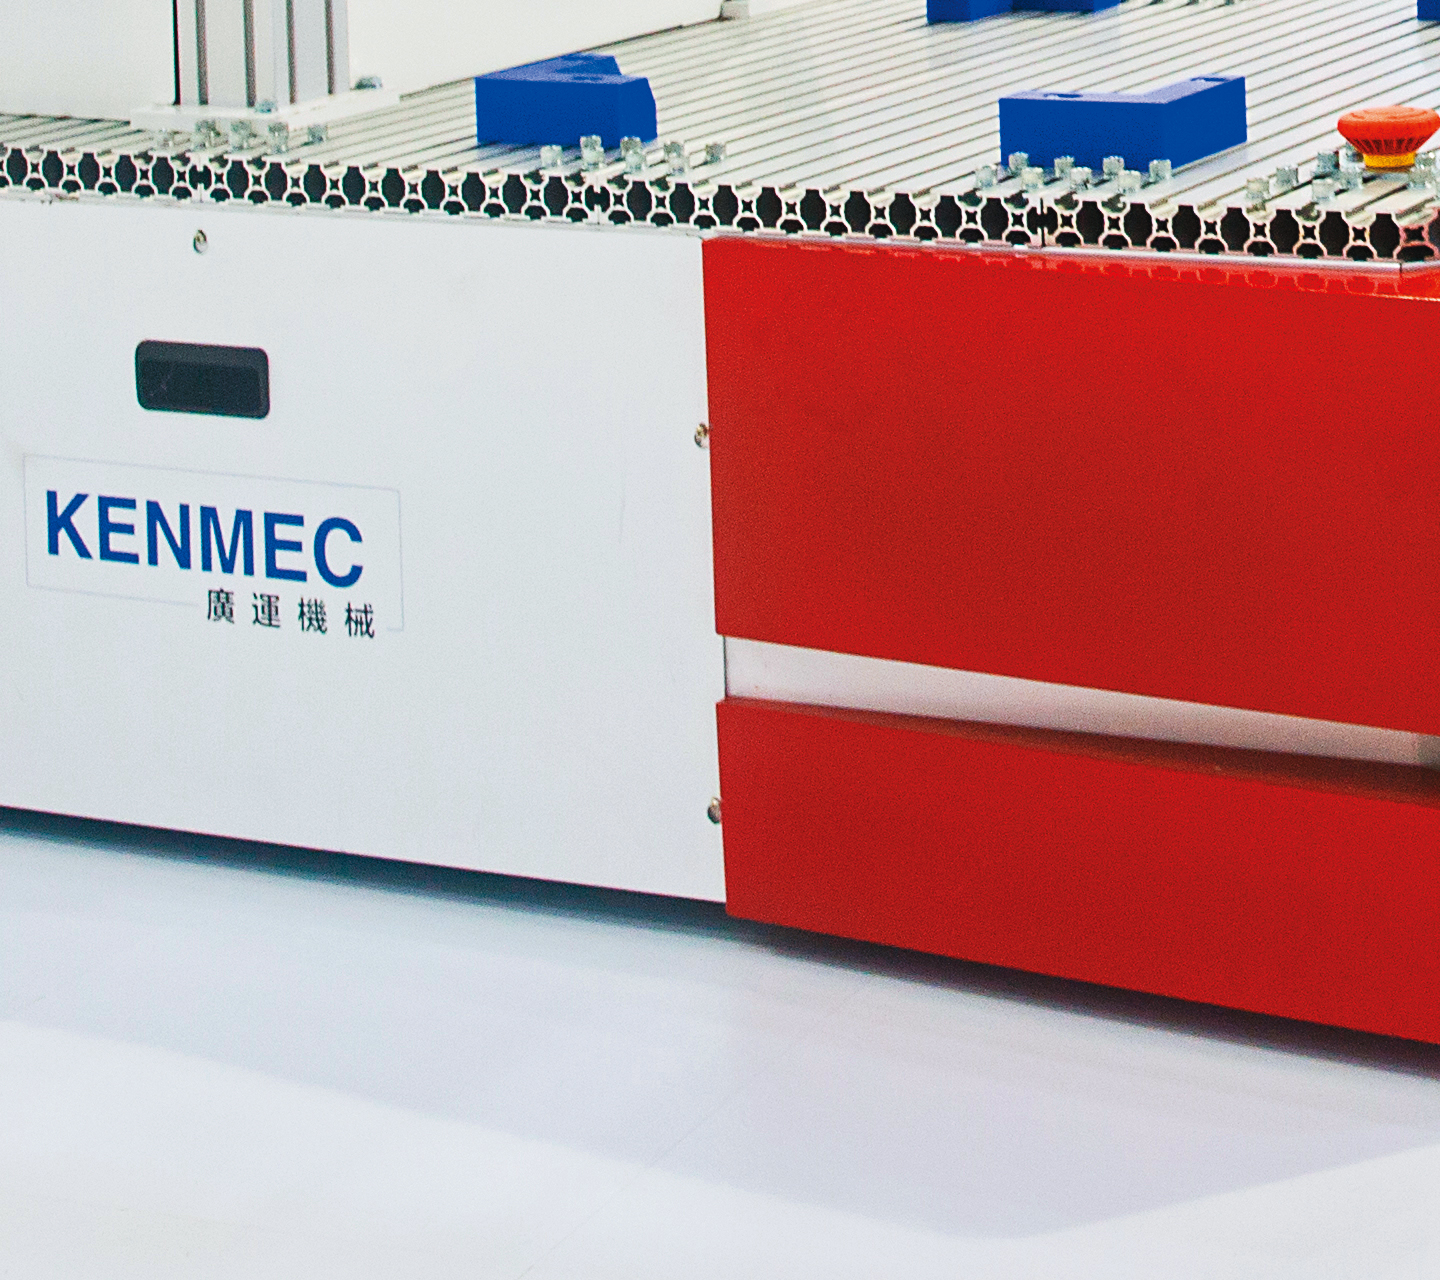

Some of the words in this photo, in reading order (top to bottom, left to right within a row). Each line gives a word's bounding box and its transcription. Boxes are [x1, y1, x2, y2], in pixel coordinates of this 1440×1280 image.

[46, 489, 364, 588] KENMEC
[207, 587, 376, 640] 廣運機械
